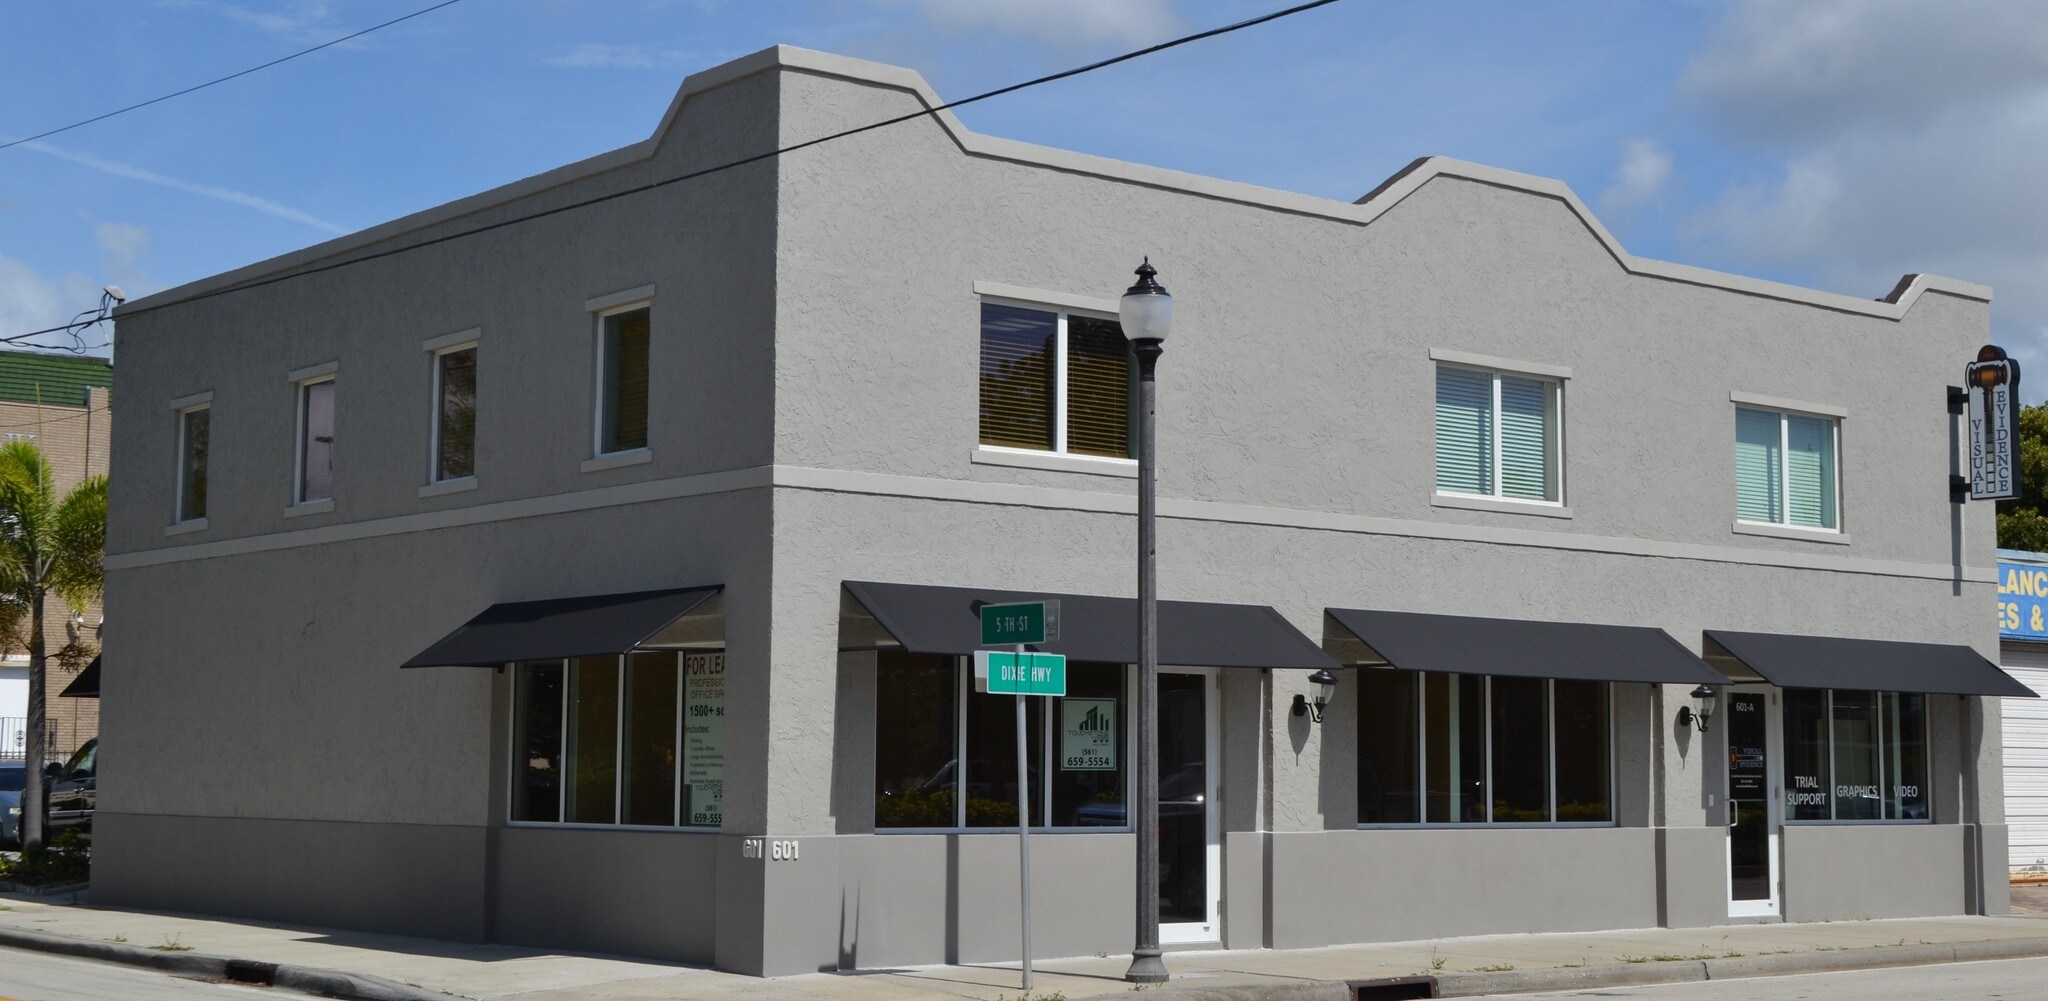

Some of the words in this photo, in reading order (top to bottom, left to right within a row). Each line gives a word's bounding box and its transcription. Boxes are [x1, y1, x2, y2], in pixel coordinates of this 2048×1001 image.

[1996, 391, 2008, 492] EVIDENCE
[1971, 419, 1984, 494] VISUAL
[1998, 569, 2048, 598] ANC
[1019, 616, 1028, 632] ST
[2030, 604, 2045, 631] &
[687, 656, 706, 675] FOR
[1001, 665, 1026, 682] DIXIE
[1031, 666, 1052, 682] HWY
[691, 690, 713, 700] OFFICE
[714, 690, 724, 699] SP
[689, 704, 714, 717] 1500+
[1736, 702, 1754, 712] 601-A
[1082, 748, 1098, 757] (561)
[1067, 757, 1110, 767] 659-5554
[1795, 776, 1819, 789] TRIAL
[1836, 785, 1878, 798] GRAPHICS
[1893, 785, 1918, 798] VIDEO
[1787, 793, 1826, 806] SUPPORT
[743, 839, 763, 859] 601
[772, 840, 799, 859] 601
